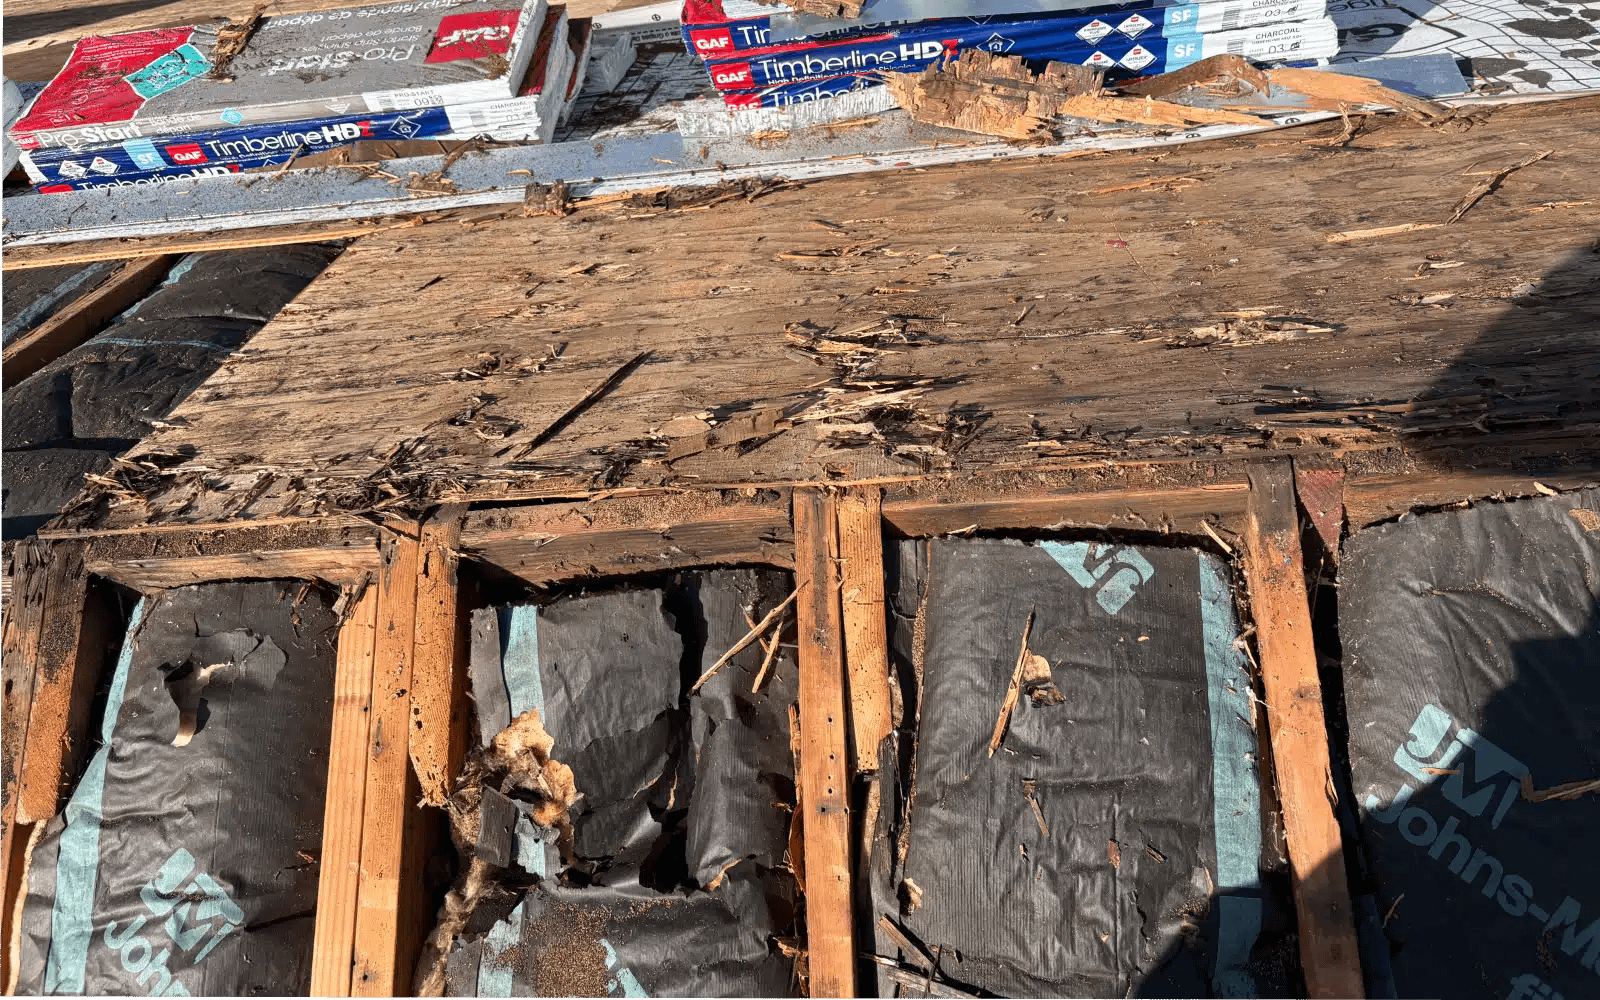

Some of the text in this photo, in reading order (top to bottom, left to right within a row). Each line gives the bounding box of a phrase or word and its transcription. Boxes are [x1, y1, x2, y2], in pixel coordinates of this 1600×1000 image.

[328, 11, 352, 20] de
[1171, 10, 1192, 23] SF
[1264, 9, 1281, 17] 03
[384, 25, 422, 34] Bande
[1255, 27, 1300, 40] CHARCOAL
[321, 32, 362, 42] départ
[438, 25, 510, 47] GAF
[696, 37, 729, 50] GAF
[1268, 44, 1284, 54] 03
[1173, 43, 1196, 57] SF
[716, 71, 748, 84] GAF
[414, 97, 430, 107] 09
[37, 122, 144, 148] Pro-Start
[137, 153, 154, 165] SF
[173, 151, 202, 162] GAF
